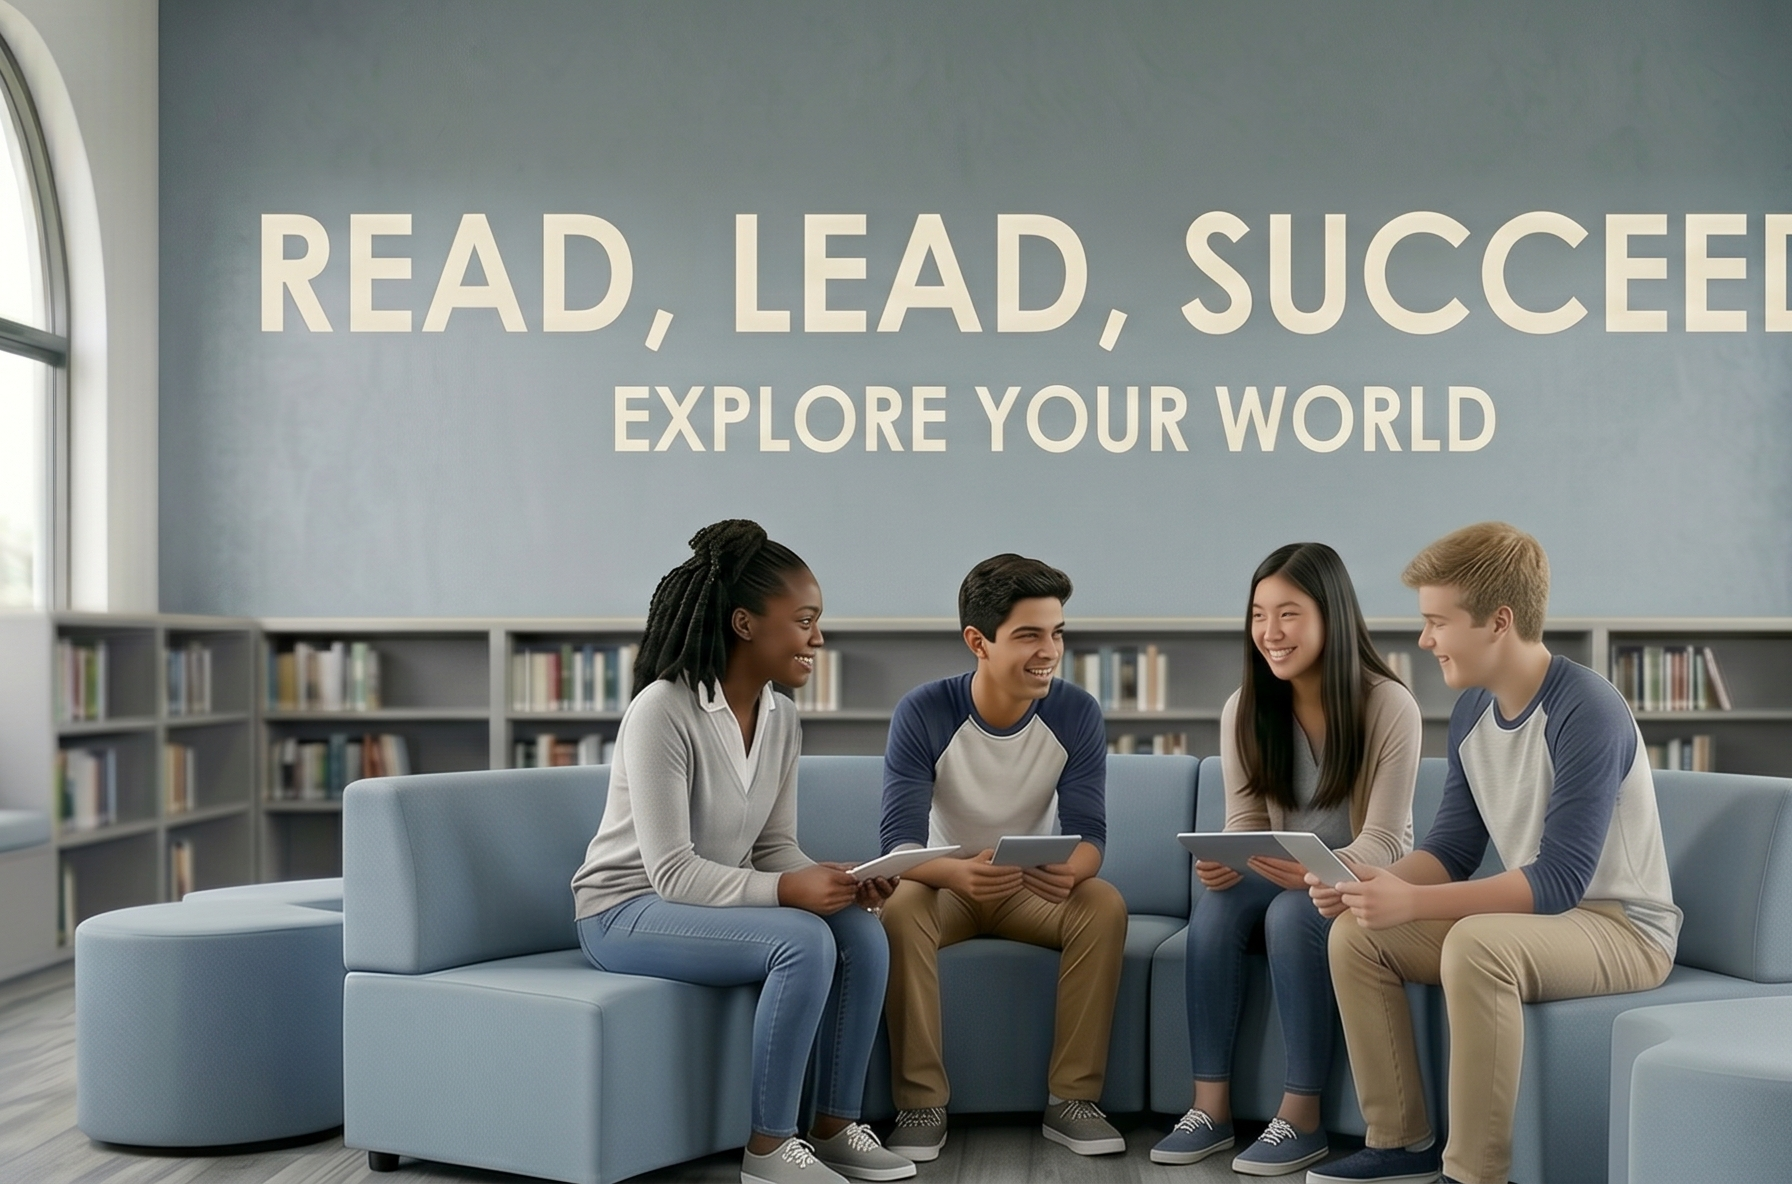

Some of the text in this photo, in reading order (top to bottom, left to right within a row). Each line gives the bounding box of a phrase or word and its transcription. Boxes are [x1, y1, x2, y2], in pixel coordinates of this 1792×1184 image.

[260, 213, 674, 352] READ,
[735, 213, 1128, 352] LEAD,
[614, 384, 1497, 454] EXPLORE YOUR WORLD
